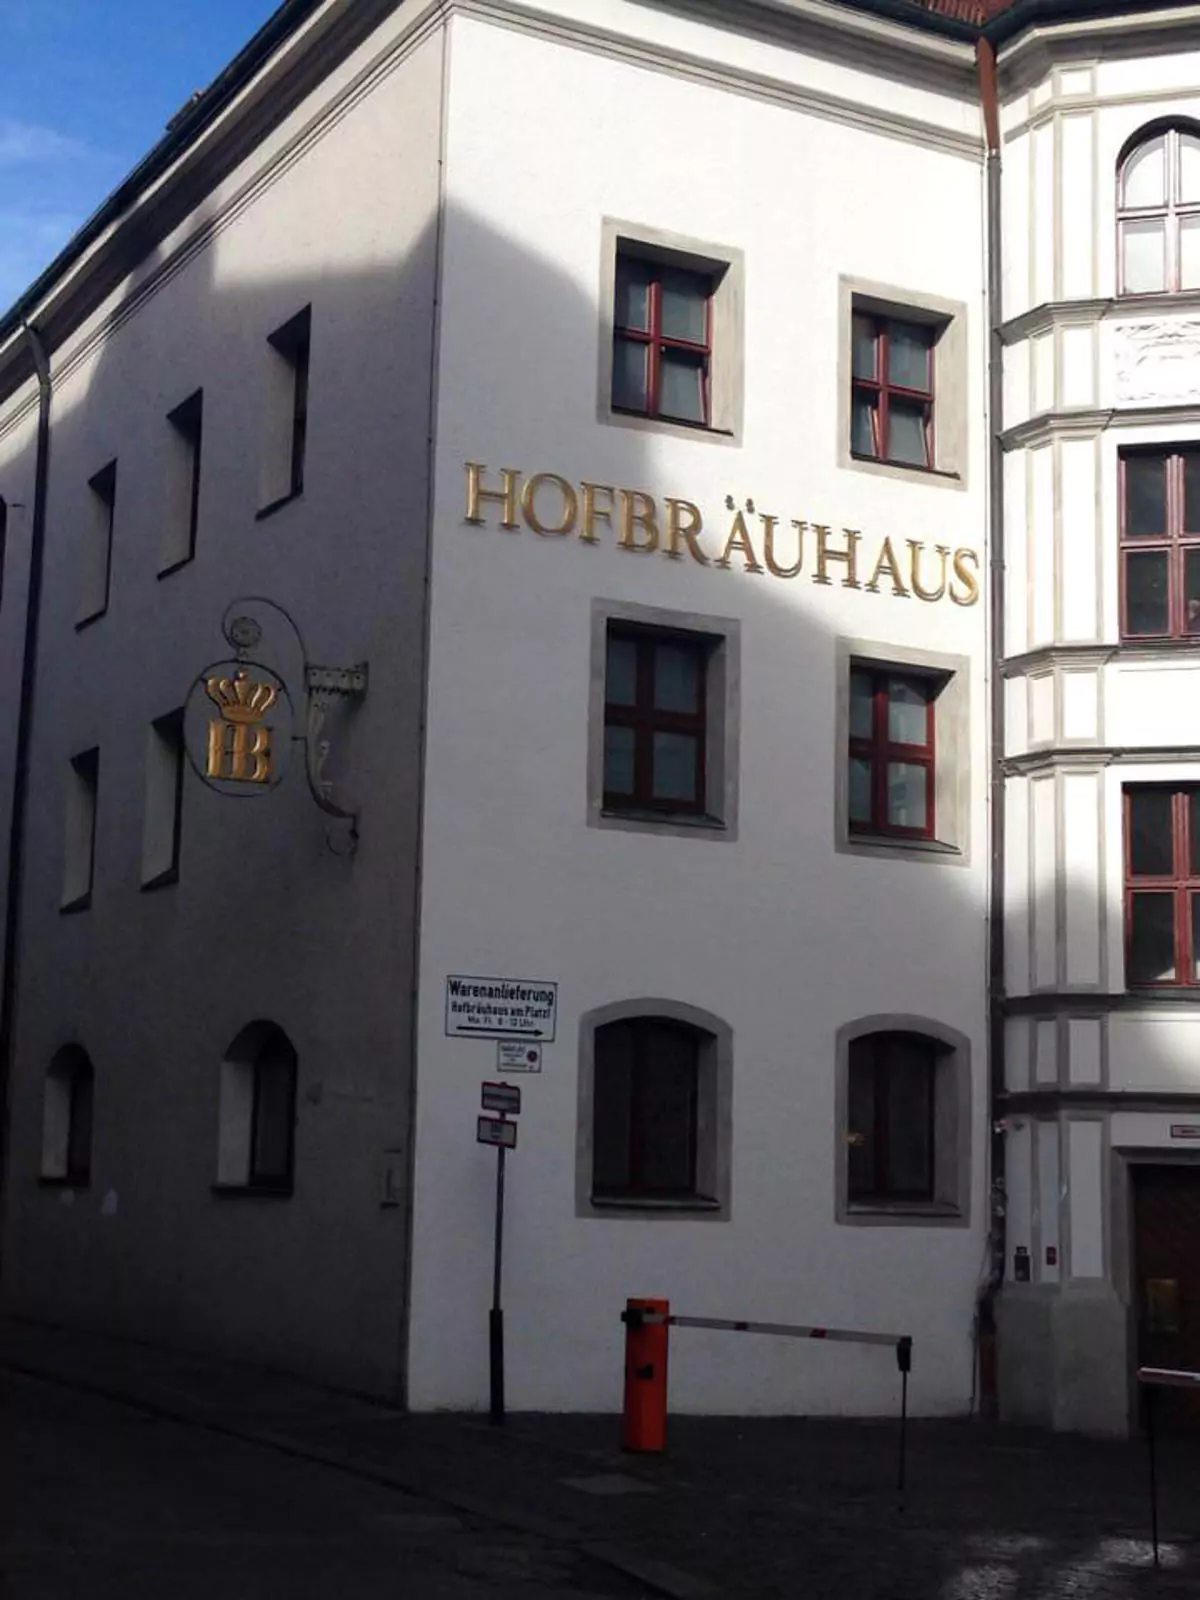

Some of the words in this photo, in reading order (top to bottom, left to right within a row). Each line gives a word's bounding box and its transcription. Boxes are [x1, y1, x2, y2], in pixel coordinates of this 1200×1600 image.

[464, 461, 980, 606] HOFBRÄUHAUS
[207, 720, 272, 782] HB
[449, 980, 554, 1006] Warenanlieferung
[511, 1008, 524, 1017] am
